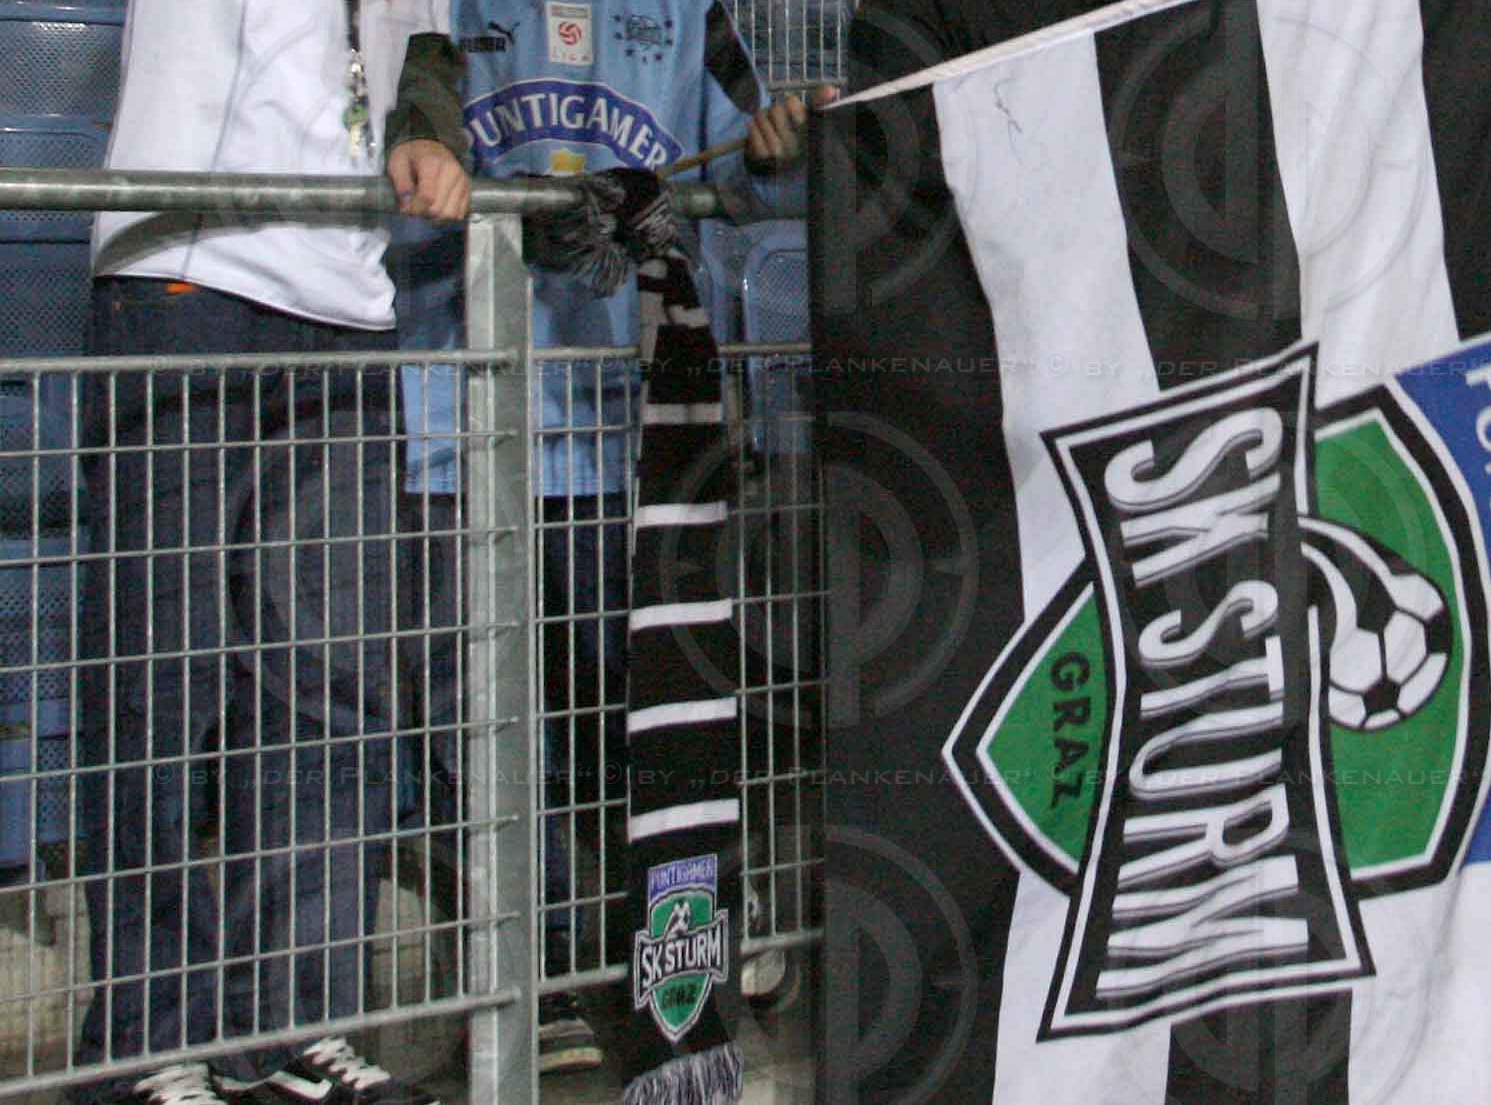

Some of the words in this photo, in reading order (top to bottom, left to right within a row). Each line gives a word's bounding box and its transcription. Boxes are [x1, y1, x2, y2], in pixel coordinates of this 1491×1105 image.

[462, 93, 668, 172] UNTIGAMER
[1103, 406, 1284, 591] SK
[1049, 651, 1093, 811] GRAZ
[1094, 579, 1310, 1000] STURM
[641, 945, 662, 987] SK
[664, 928, 720, 972] STURM
